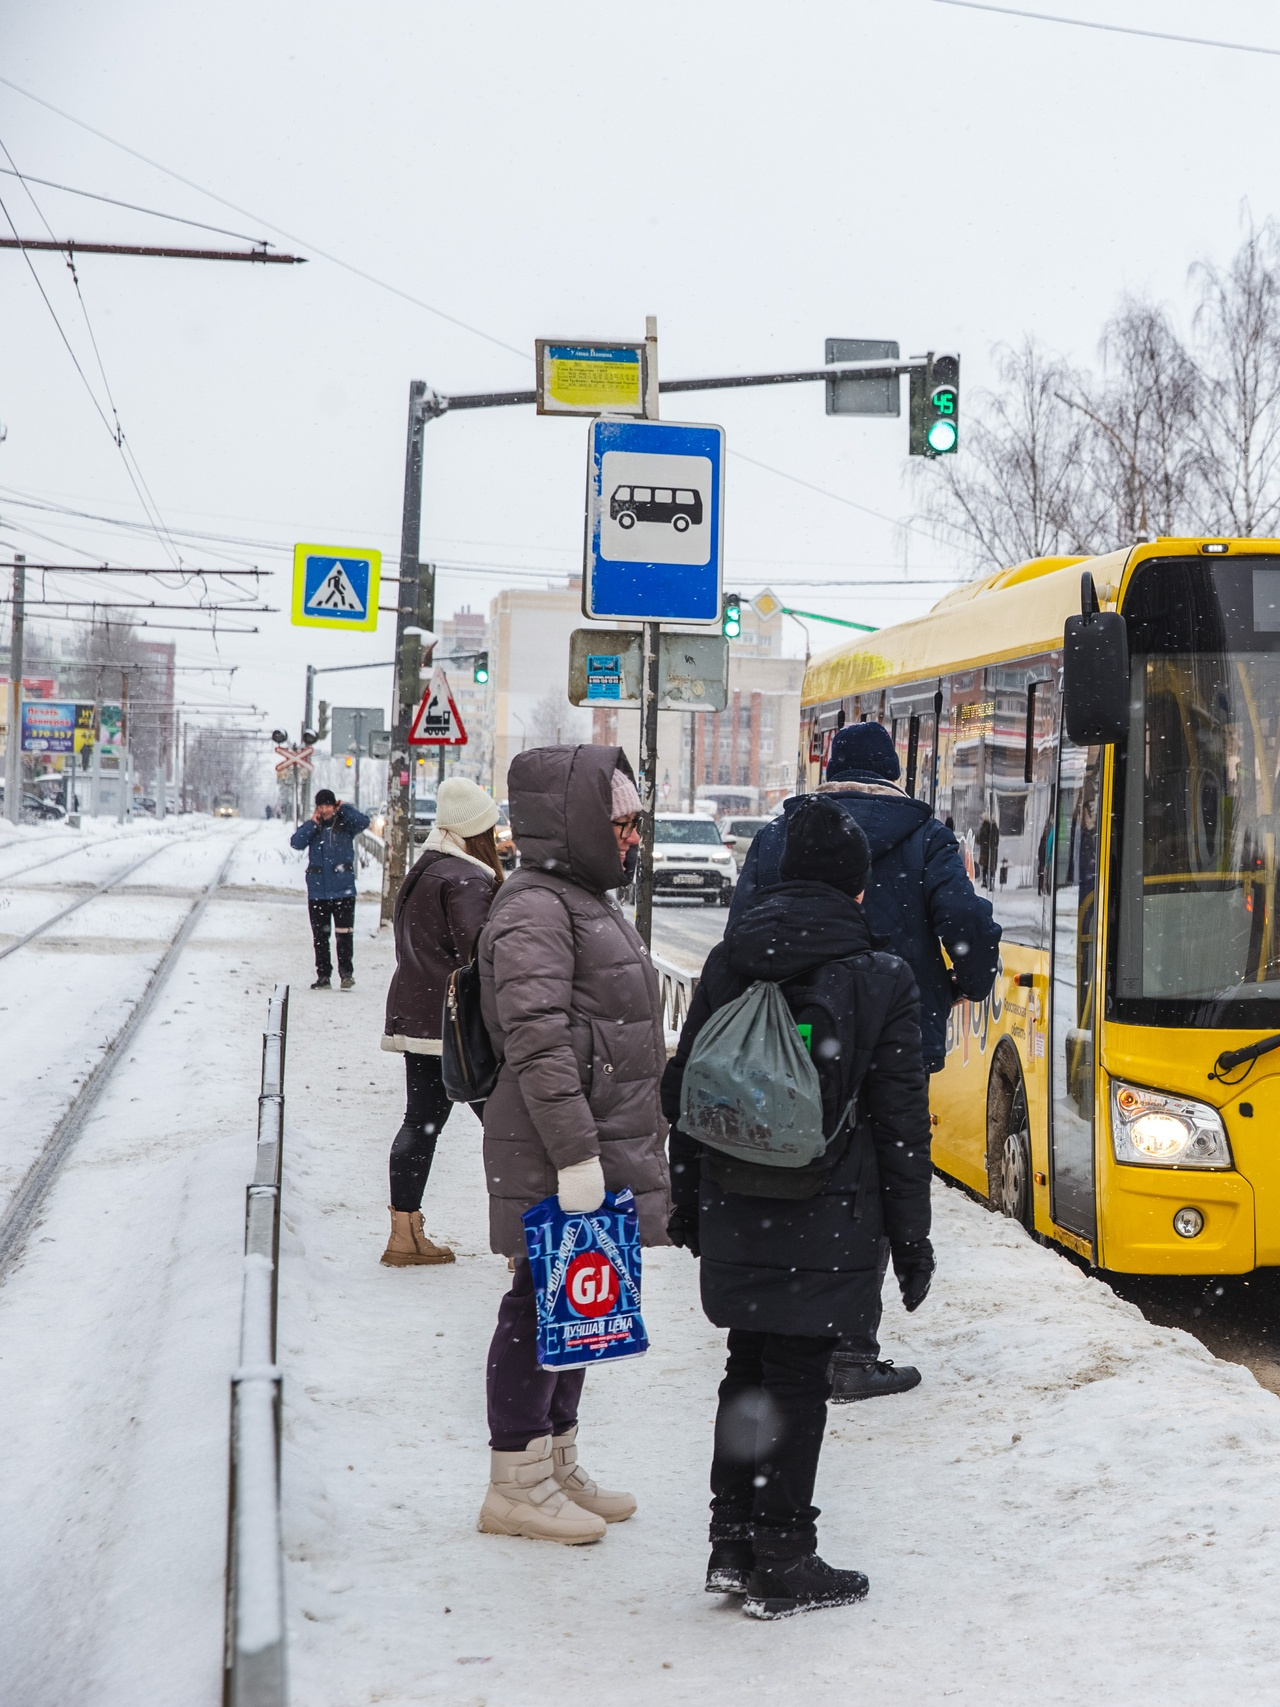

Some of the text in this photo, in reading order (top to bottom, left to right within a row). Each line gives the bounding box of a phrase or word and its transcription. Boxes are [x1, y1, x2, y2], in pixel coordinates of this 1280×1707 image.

[934, 394, 954, 414] 45
[572, 1265, 610, 1304] GJ
[562, 1317, 633, 1339] ЛУЧШАЯ ЦЕНА
